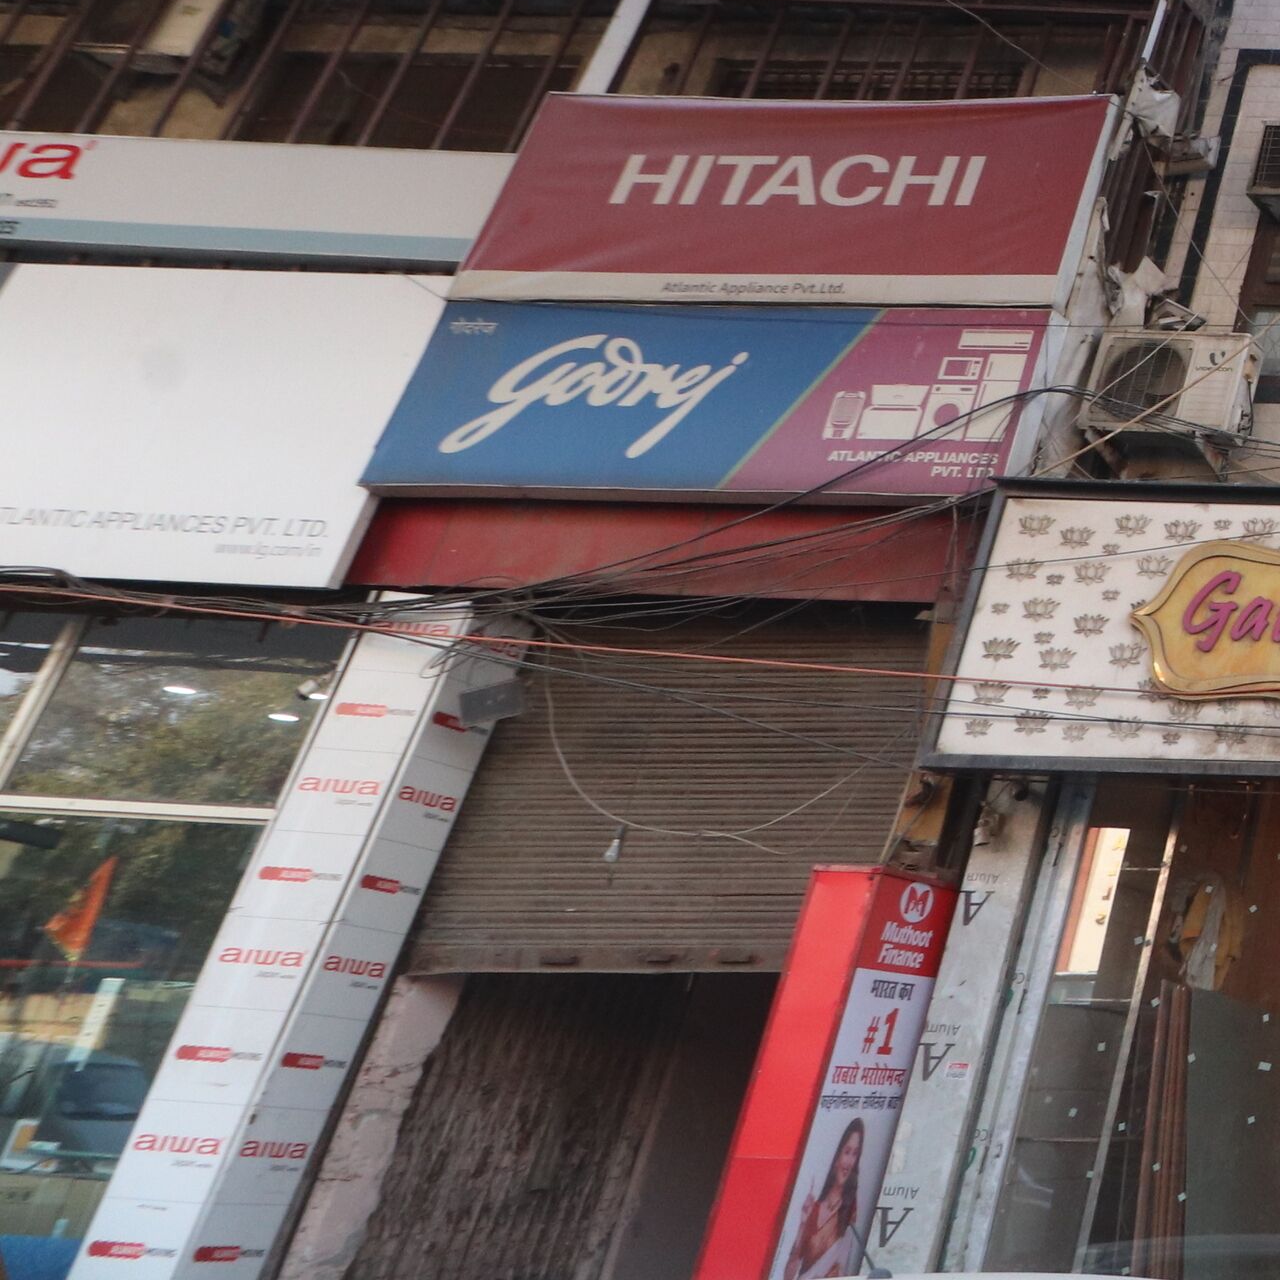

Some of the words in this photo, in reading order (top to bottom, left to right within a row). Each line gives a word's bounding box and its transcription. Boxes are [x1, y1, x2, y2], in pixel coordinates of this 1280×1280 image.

[608, 153, 986, 208] HITACHI
[662, 281, 716, 294] Atlantic
[720, 282, 790, 296] Appliance
[827, 449, 902, 463] ATLANTIC
[904, 451, 999, 465] APPLIANCES
[90, 509, 227, 535] APPLIANCES
[298, 775, 382, 796] aiwa
[398, 785, 459, 812] aiwa
[881, 920, 933, 948] Muthoot
[218, 946, 305, 968] aiwa
[322, 954, 387, 979] aiwa
[877, 943, 925, 968] Finance
[861, 1007, 899, 1056] #1
[133, 1133, 223, 1156] aiwa
[239, 1139, 310, 1160] aiwa
